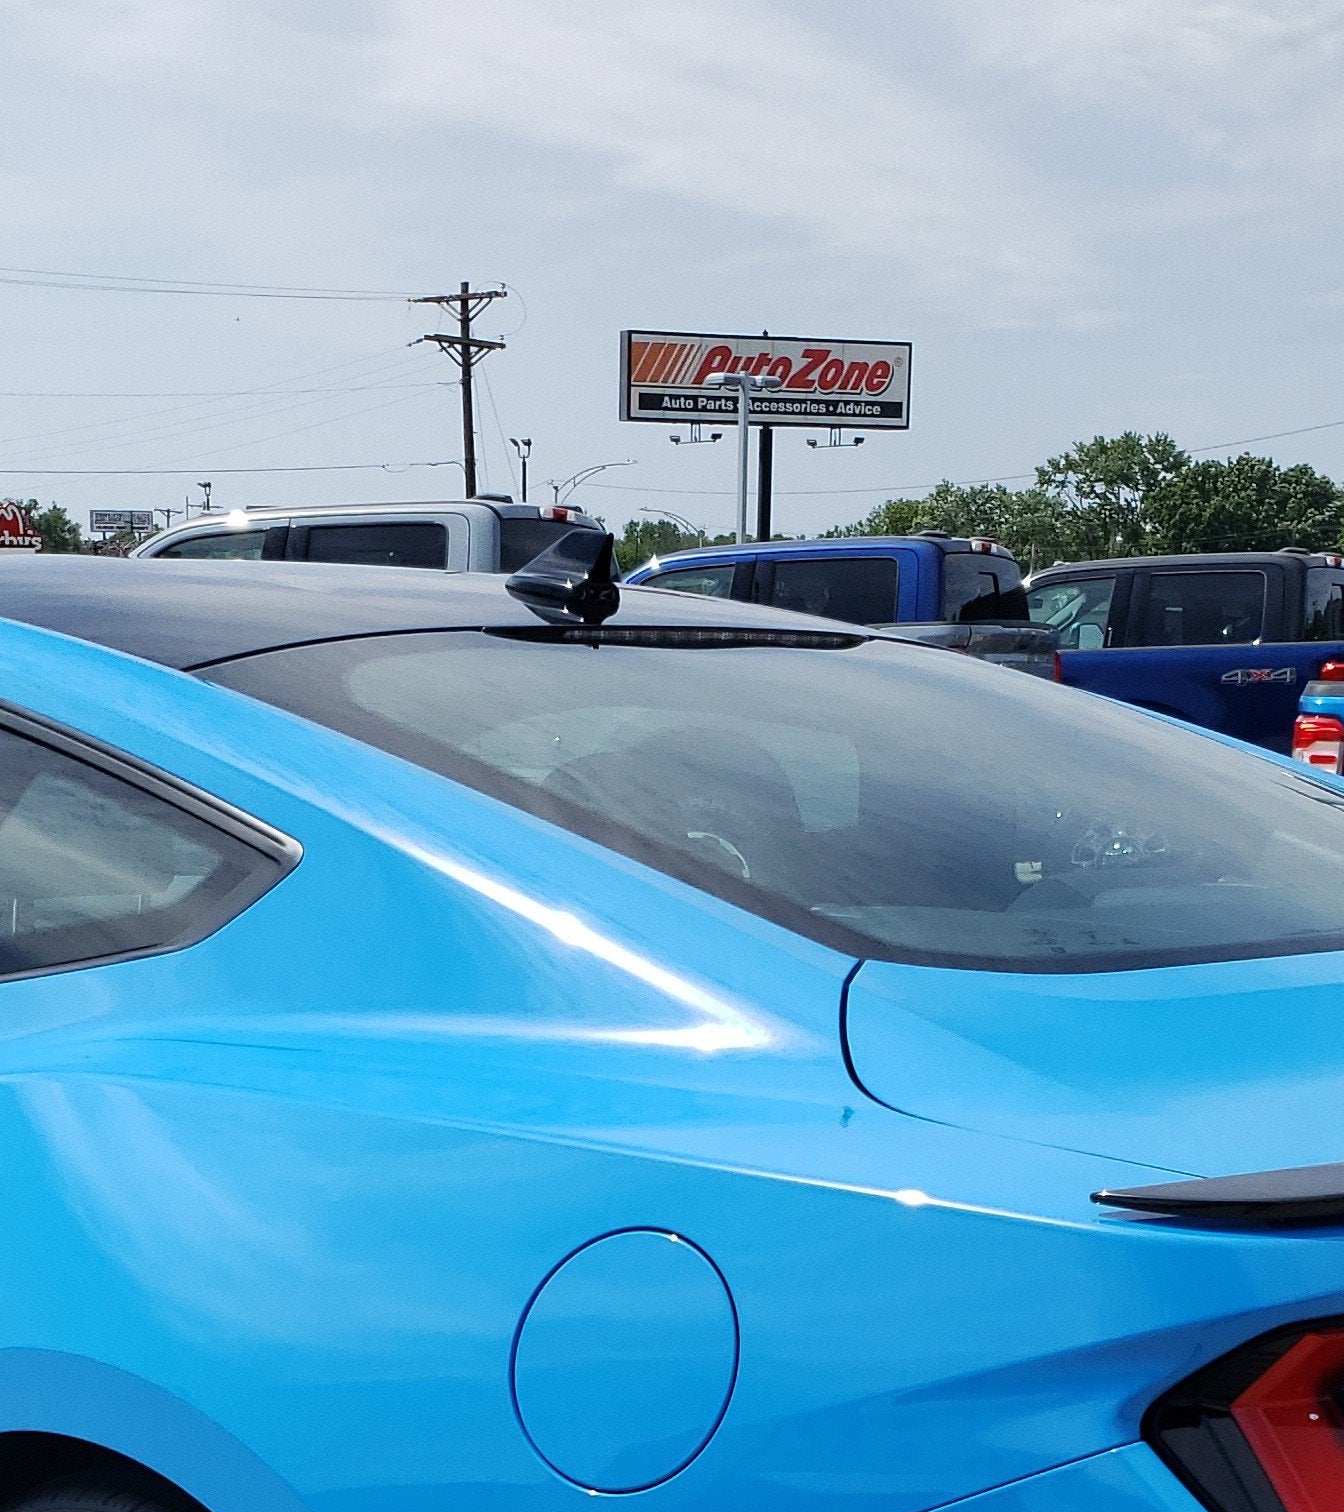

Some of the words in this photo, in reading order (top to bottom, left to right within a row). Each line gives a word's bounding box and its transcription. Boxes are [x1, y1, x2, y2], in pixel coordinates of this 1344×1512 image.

[691, 344, 893, 396] AutoZone
[661, 396, 694, 409] Auto
[697, 398, 734, 411] Parts
[836, 402, 882, 415] Advice
